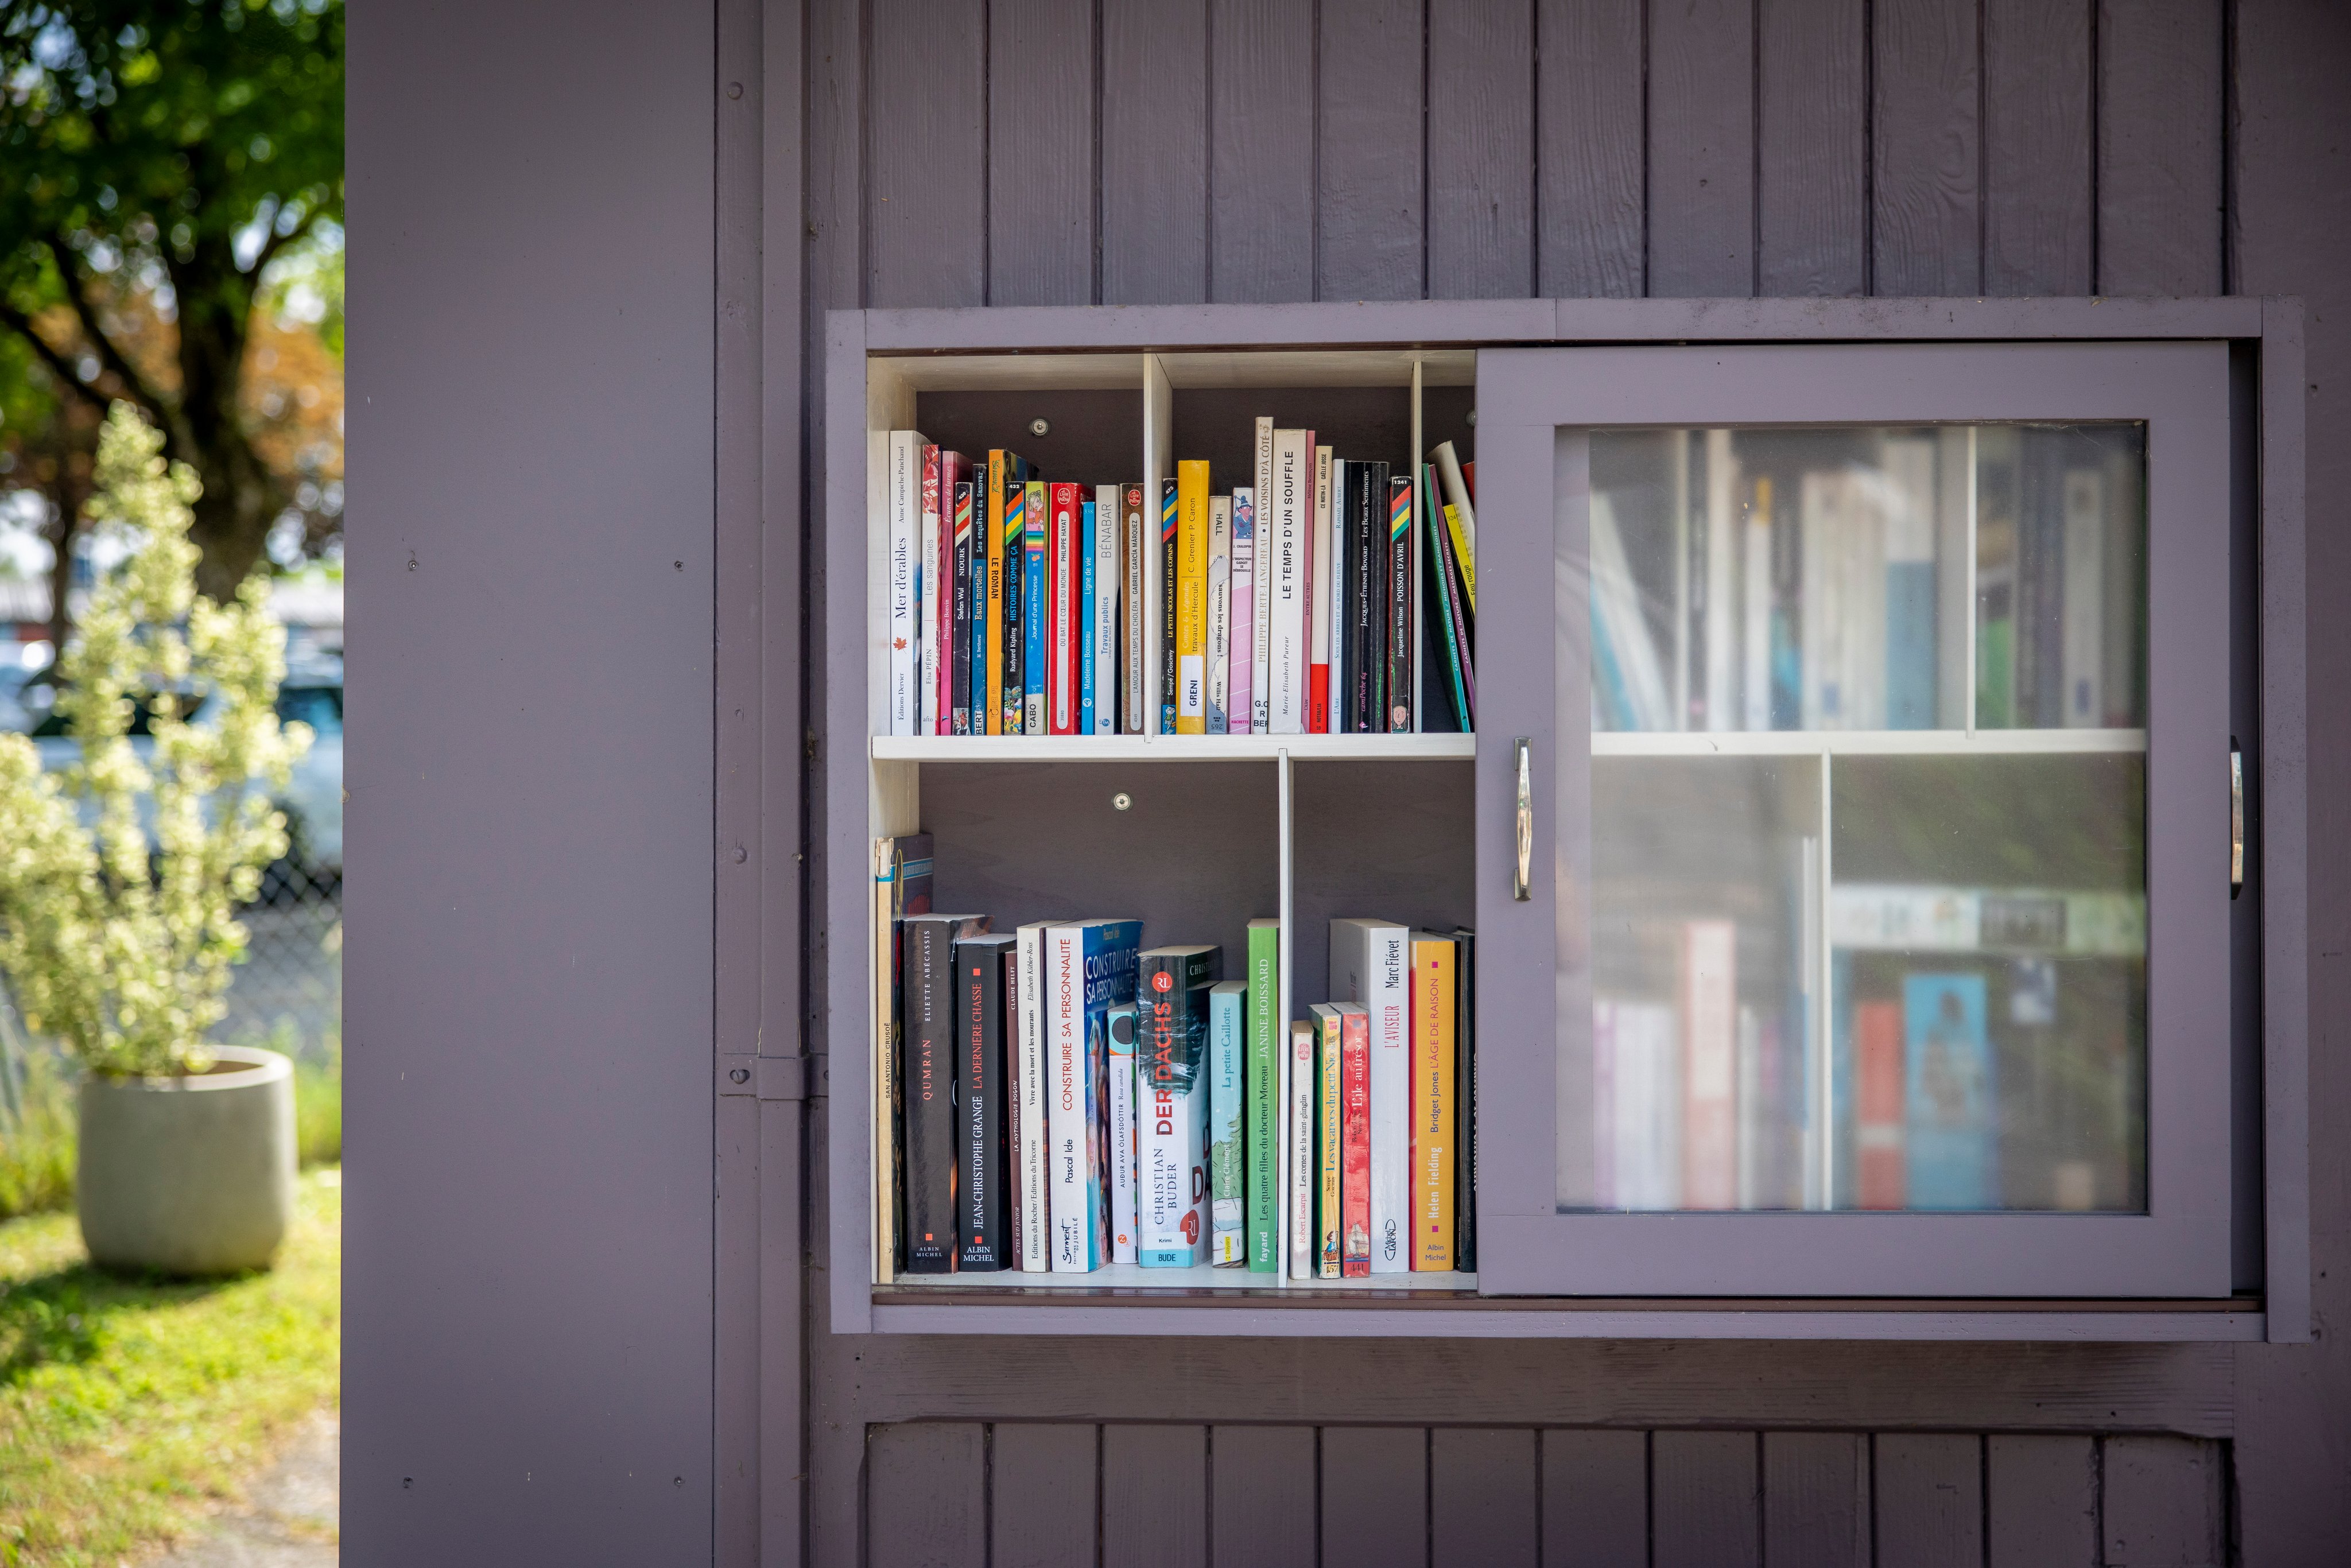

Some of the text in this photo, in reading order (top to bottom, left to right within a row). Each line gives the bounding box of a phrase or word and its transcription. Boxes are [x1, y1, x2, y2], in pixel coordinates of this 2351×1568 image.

[898, 446, 906, 506] Campiche-Panchaud
[976, 511, 984, 539] enquêtes
[977, 500, 983, 508] du
[1282, 451, 1293, 599] LE TEMPS D'UN SOUFFLE
[1010, 546, 1018, 555] ÇA
[1098, 504, 1111, 558] BÉNABAR
[895, 538, 906, 619] Mer d'érables
[925, 540, 934, 595] Les sanguines
[992, 557, 999, 567] LE
[1085, 568, 1091, 576] de
[1168, 579, 1173, 587] ET
[1188, 565, 1194, 573] C.
[1101, 597, 1110, 623] publics
[1189, 680, 1198, 707] GRENI
[1385, 940, 1399, 988] Marc Fiévet
[1060, 939, 1073, 1111] CONSTRUIRE SA PERSONNALITÉ
[1259, 959, 1268, 1059] JANINE BOISSARD
[922, 1039, 933, 1100] QUMRAN
[1154, 1003, 1173, 1135] DER DACHS
[1221, 1007, 1234, 1088] La petite Caillotte
[1299, 1094, 1308, 1137] saint-glinglin
[1430, 1072, 1441, 1133] Bridget Jones
[1014, 1144, 1019, 1152] LA
[1064, 1139, 1074, 1183] Pascal Ide
[1259, 1066, 1270, 1221] Les quatre filles du docteur Moreau
[1299, 1144, 1306, 1153] de
[1154, 1148, 1164, 1225] CHRISTIAN
[1167, 1163, 1177, 1209] BUDER
[1427, 1147, 1442, 1218] Helen Fielding
[1299, 1193, 1308, 1220] Escarpit
[1158, 1253, 1176, 1262] BUDE
[1259, 1232, 1270, 1262] fayard
